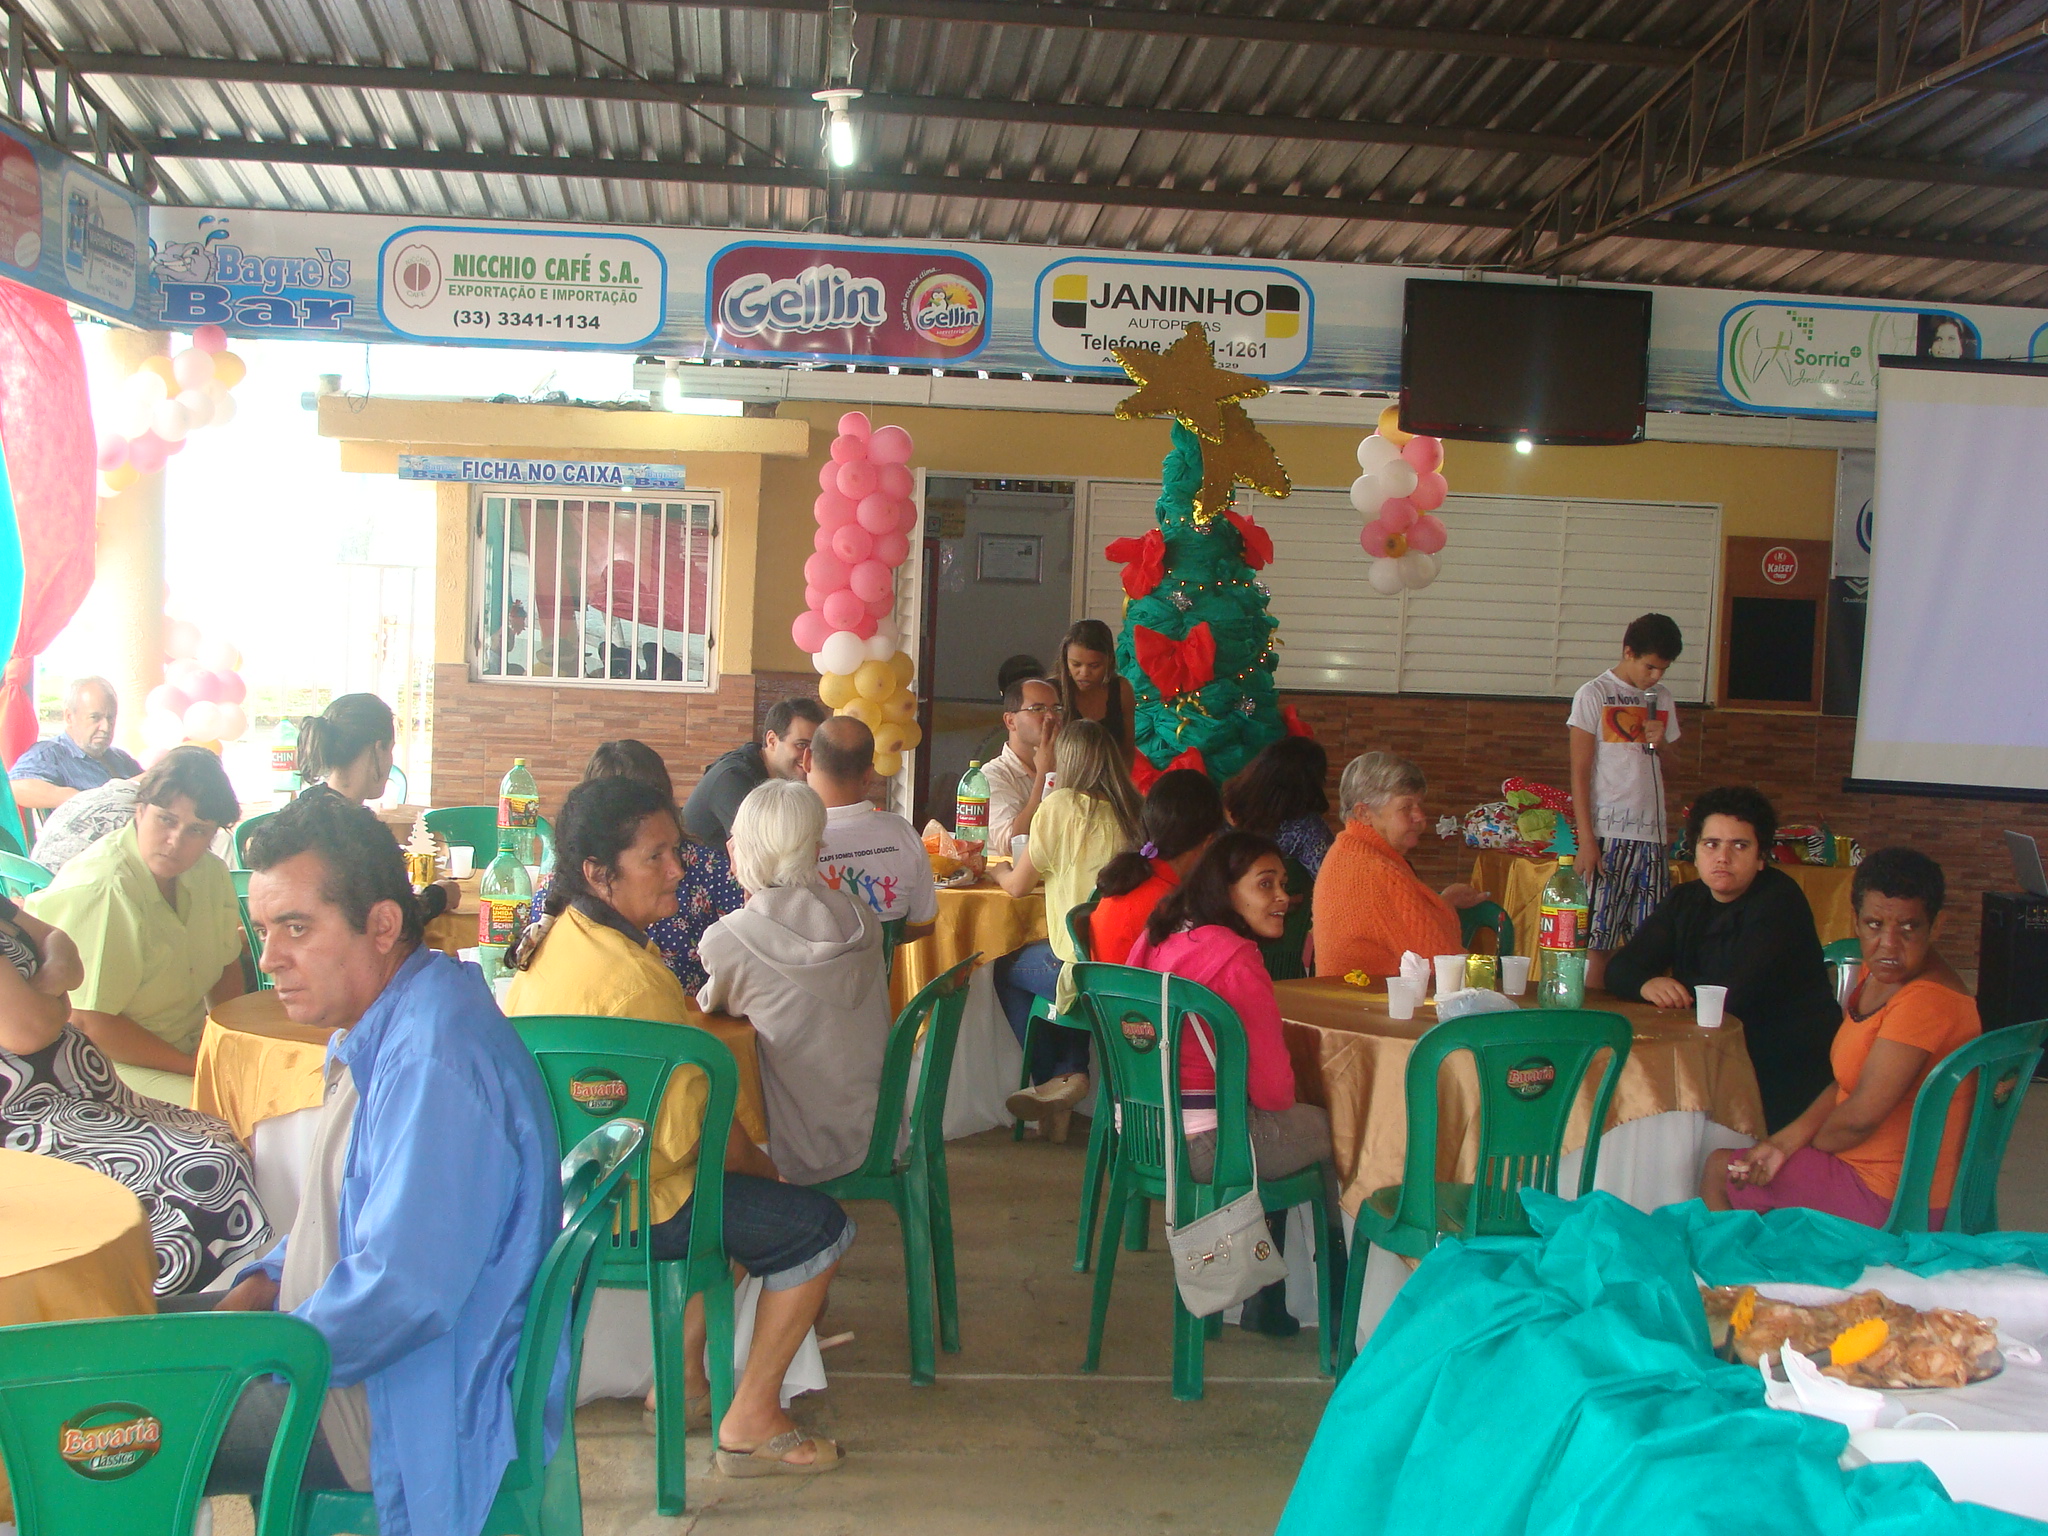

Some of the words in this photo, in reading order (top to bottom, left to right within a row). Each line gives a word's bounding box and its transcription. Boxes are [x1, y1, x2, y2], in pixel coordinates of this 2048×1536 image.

[453, 254, 536, 281] NICCHIO
[545, 253, 591, 283] CAFÉ
[599, 260, 640, 284] S.A.
[448, 285, 536, 301] EXPORTAÇÃO
[541, 289, 548, 299] E
[552, 289, 638, 305] IMPORTAÇÃO
[720, 264, 887, 337] Gellin
[1090, 282, 1264, 316] JANINHO
[159, 282, 354, 331] Bar
[453, 310, 491, 328] (33)
[497, 313, 601, 330] 3341-1134
[917, 304, 982, 330] Gellin
[1128, 318, 1221, 332] AUTOPEAS
[1081, 333, 1161, 354] Telefone
[1794, 347, 1850, 367] Sorria
[462, 460, 522, 480] FICHA
[527, 463, 557, 482] NO
[562, 464, 624, 485] CAIXA
[1767, 563, 1794, 573] Kaiser
[1618, 693, 1640, 706] Novo
[854, 848, 873, 857] TODOS
[572, 1080, 626, 1097] Bavaria
[63, 1418, 160, 1454] Bavaria
